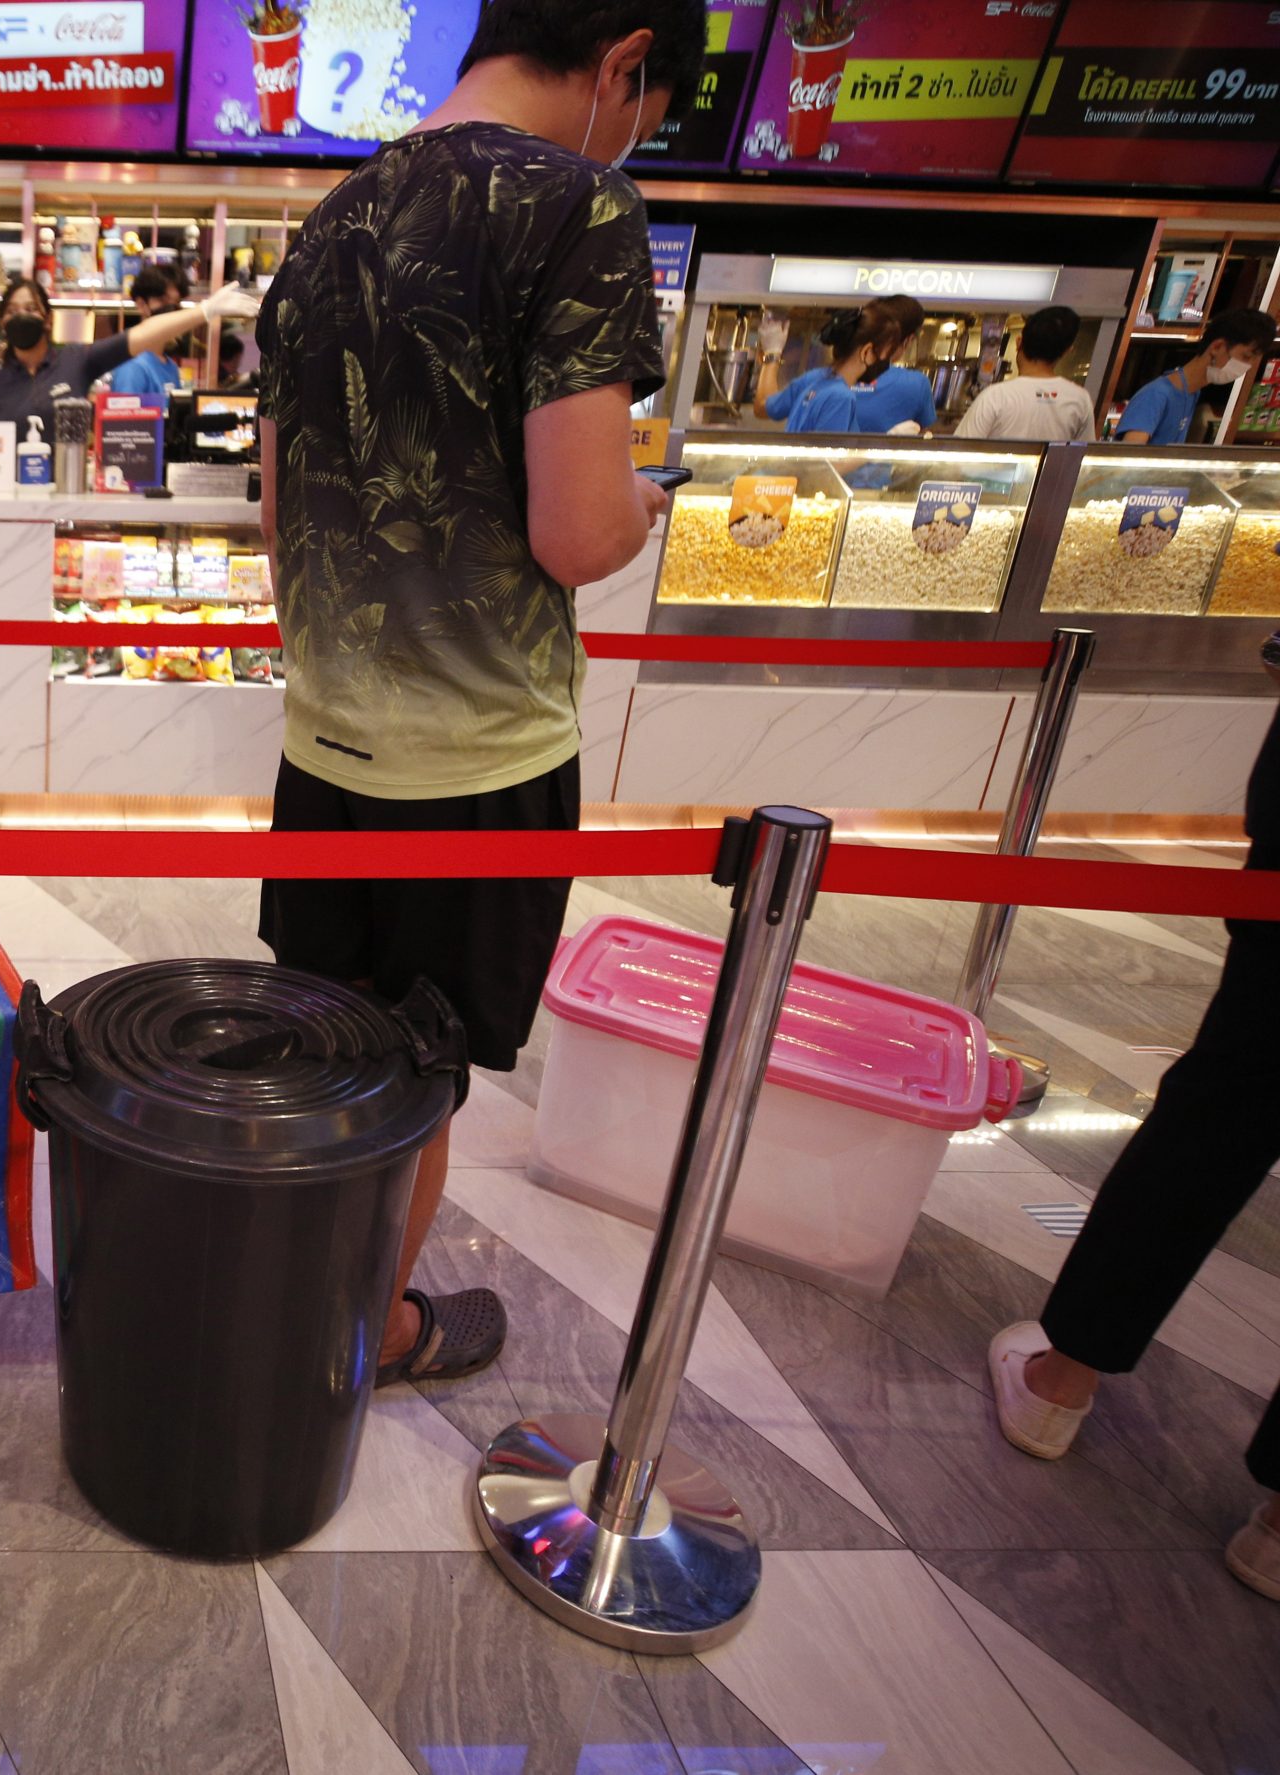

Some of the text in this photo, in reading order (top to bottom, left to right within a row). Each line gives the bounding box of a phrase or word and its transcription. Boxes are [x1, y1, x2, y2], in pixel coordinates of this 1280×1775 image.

[905, 74, 923, 99] 2
[1129, 79, 1197, 100] REFILL
[1204, 68, 1247, 100] 99
[649, 240, 685, 252] ELIVERY
[854, 268, 974, 294] POPCORN
[920, 490, 978, 504] ORIGINAL
[1128, 494, 1185, 508] ORIGINAL
